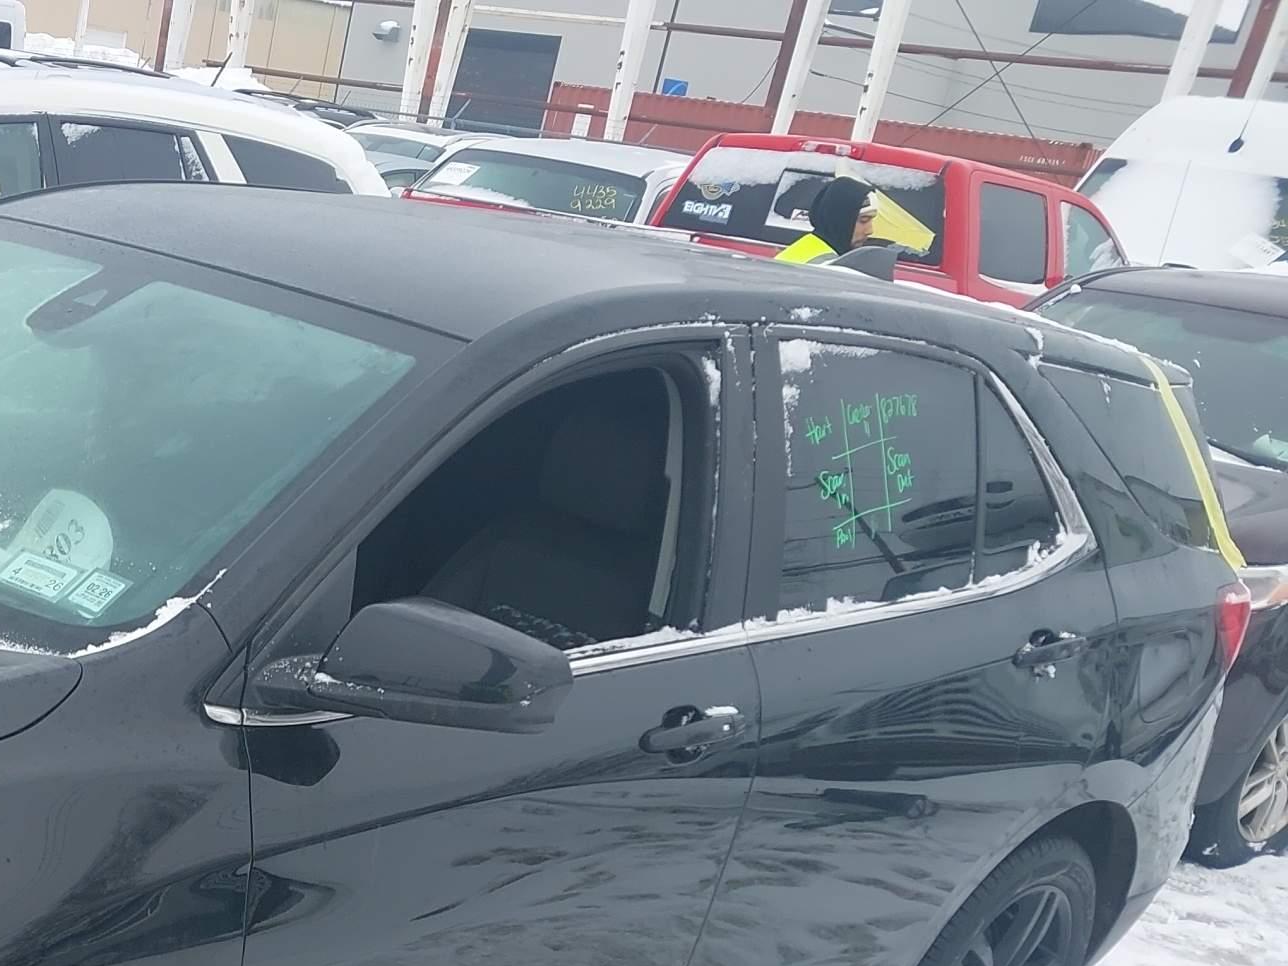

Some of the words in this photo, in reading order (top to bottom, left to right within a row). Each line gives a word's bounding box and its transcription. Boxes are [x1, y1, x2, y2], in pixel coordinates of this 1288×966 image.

[573, 183, 617, 199] 4435
[570, 197, 616, 212] 9229
[44, 579, 64, 592] 26
